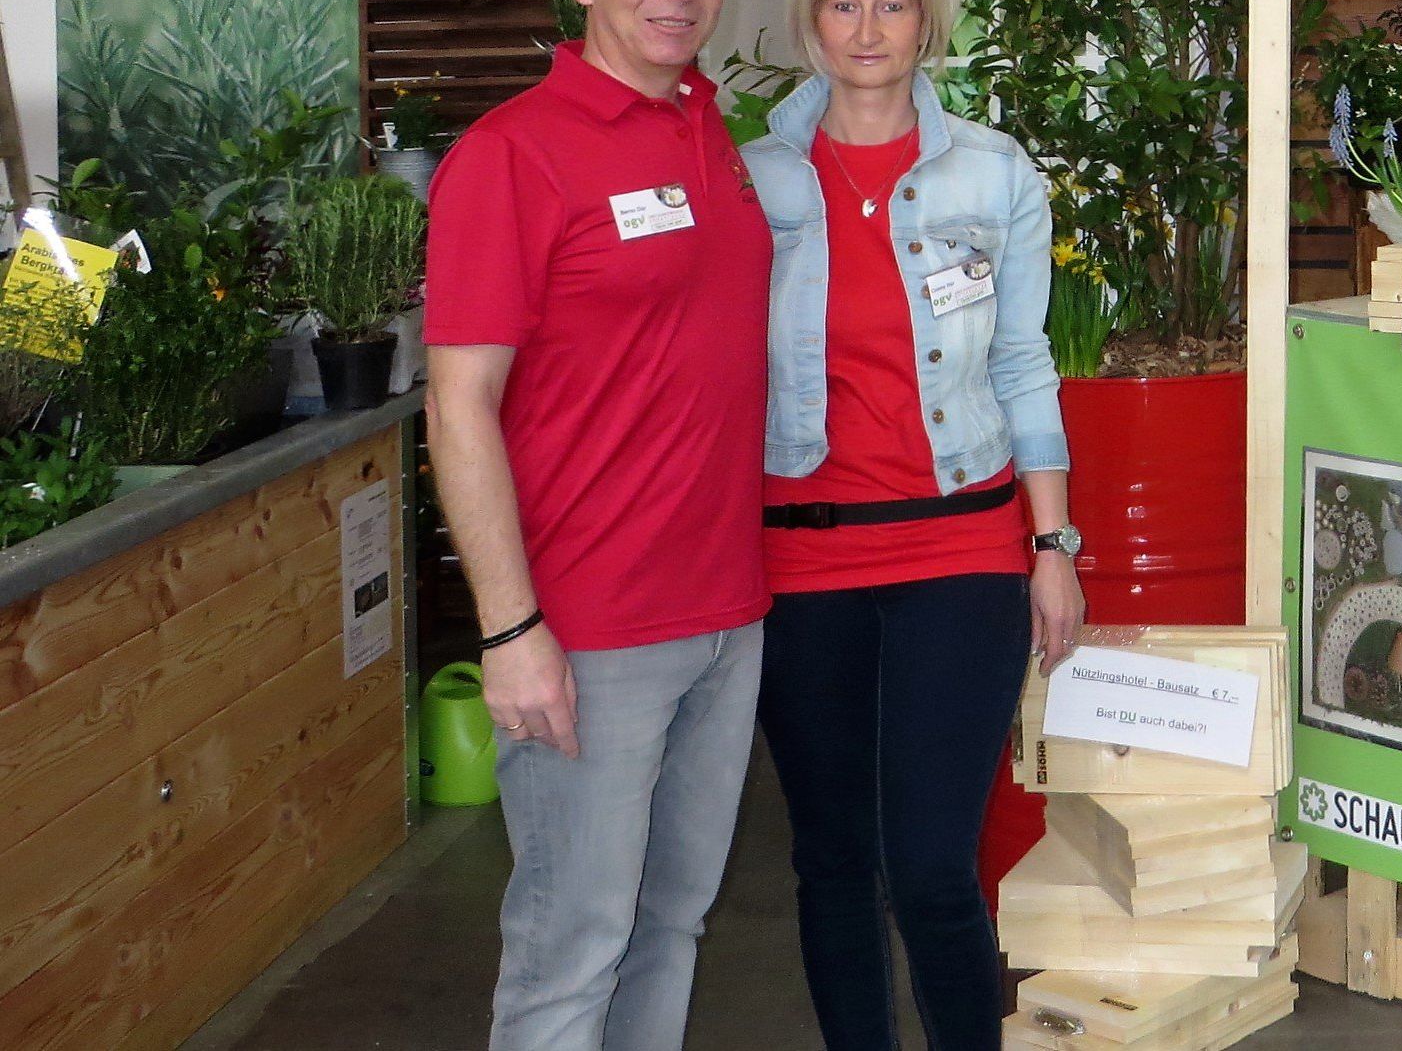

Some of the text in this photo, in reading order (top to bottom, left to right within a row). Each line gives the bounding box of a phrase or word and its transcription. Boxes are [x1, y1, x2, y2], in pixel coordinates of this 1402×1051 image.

[1071, 666, 1148, 687] Nützlingshotel
[1157, 678, 1200, 695] Bausatz
[1212, 688, 1219, 698] €
[1096, 706, 1208, 734] Bist DU auch dabei?!
